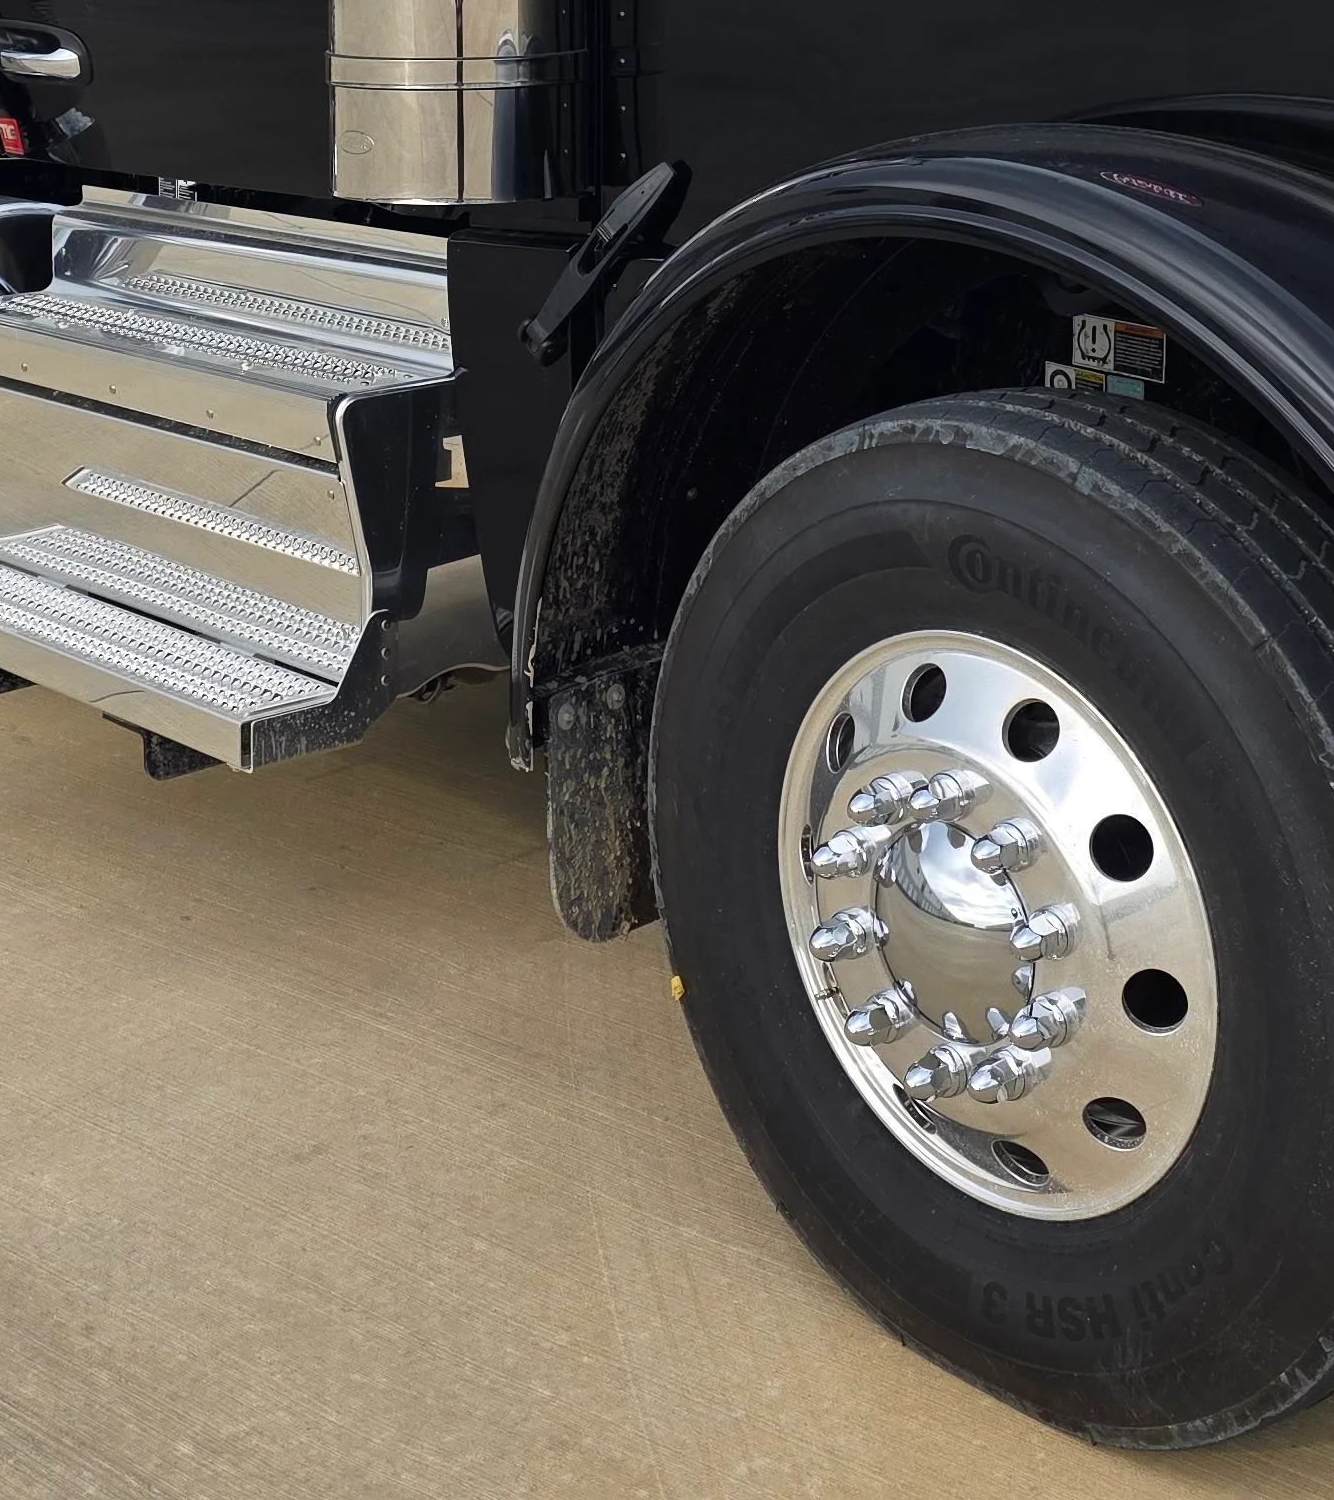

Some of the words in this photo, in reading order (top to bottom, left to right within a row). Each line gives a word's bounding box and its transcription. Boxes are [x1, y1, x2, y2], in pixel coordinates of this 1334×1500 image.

[979, 1280, 1011, 1329] 3
[1129, 1231, 1234, 1332] Conti
[1024, 1290, 1123, 1343] HSR
